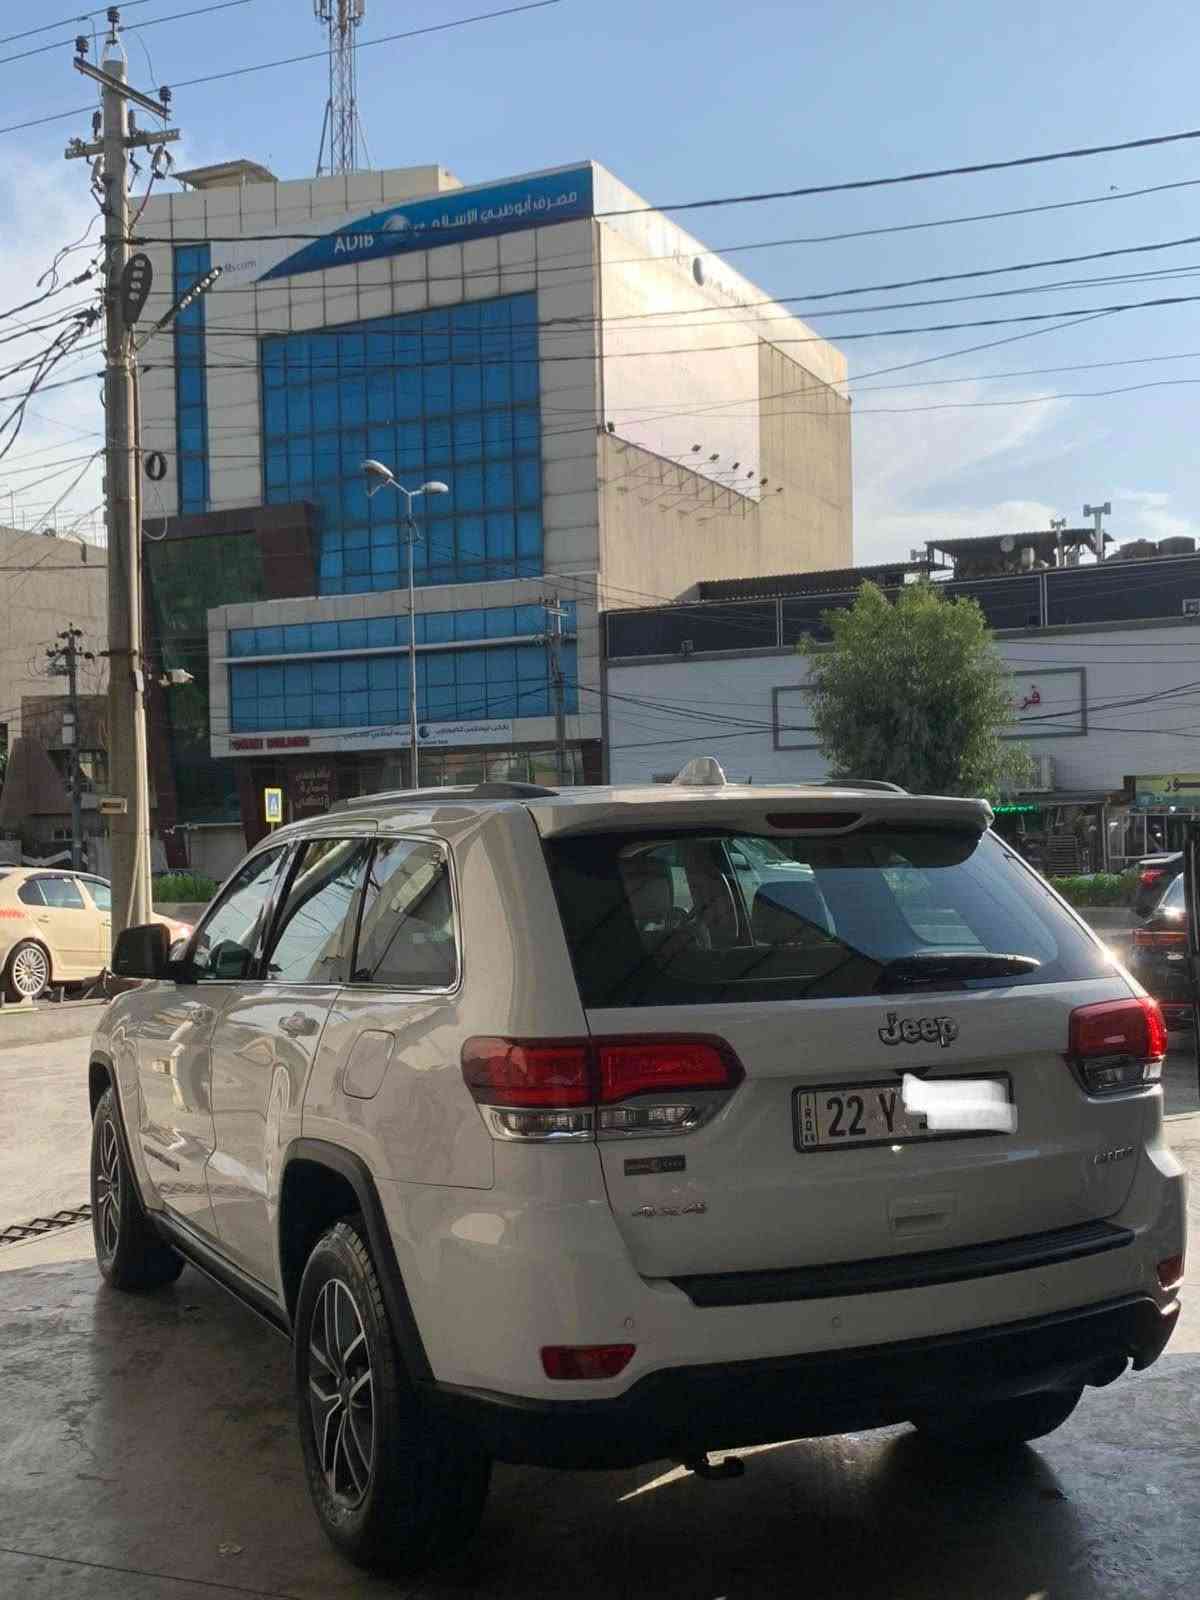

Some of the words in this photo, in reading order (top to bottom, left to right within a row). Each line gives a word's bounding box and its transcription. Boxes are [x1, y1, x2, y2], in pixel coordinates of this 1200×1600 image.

[878, 1013, 960, 1048] Jeep
[826, 1095, 867, 1137] 22
[879, 1091, 896, 1133] Y
